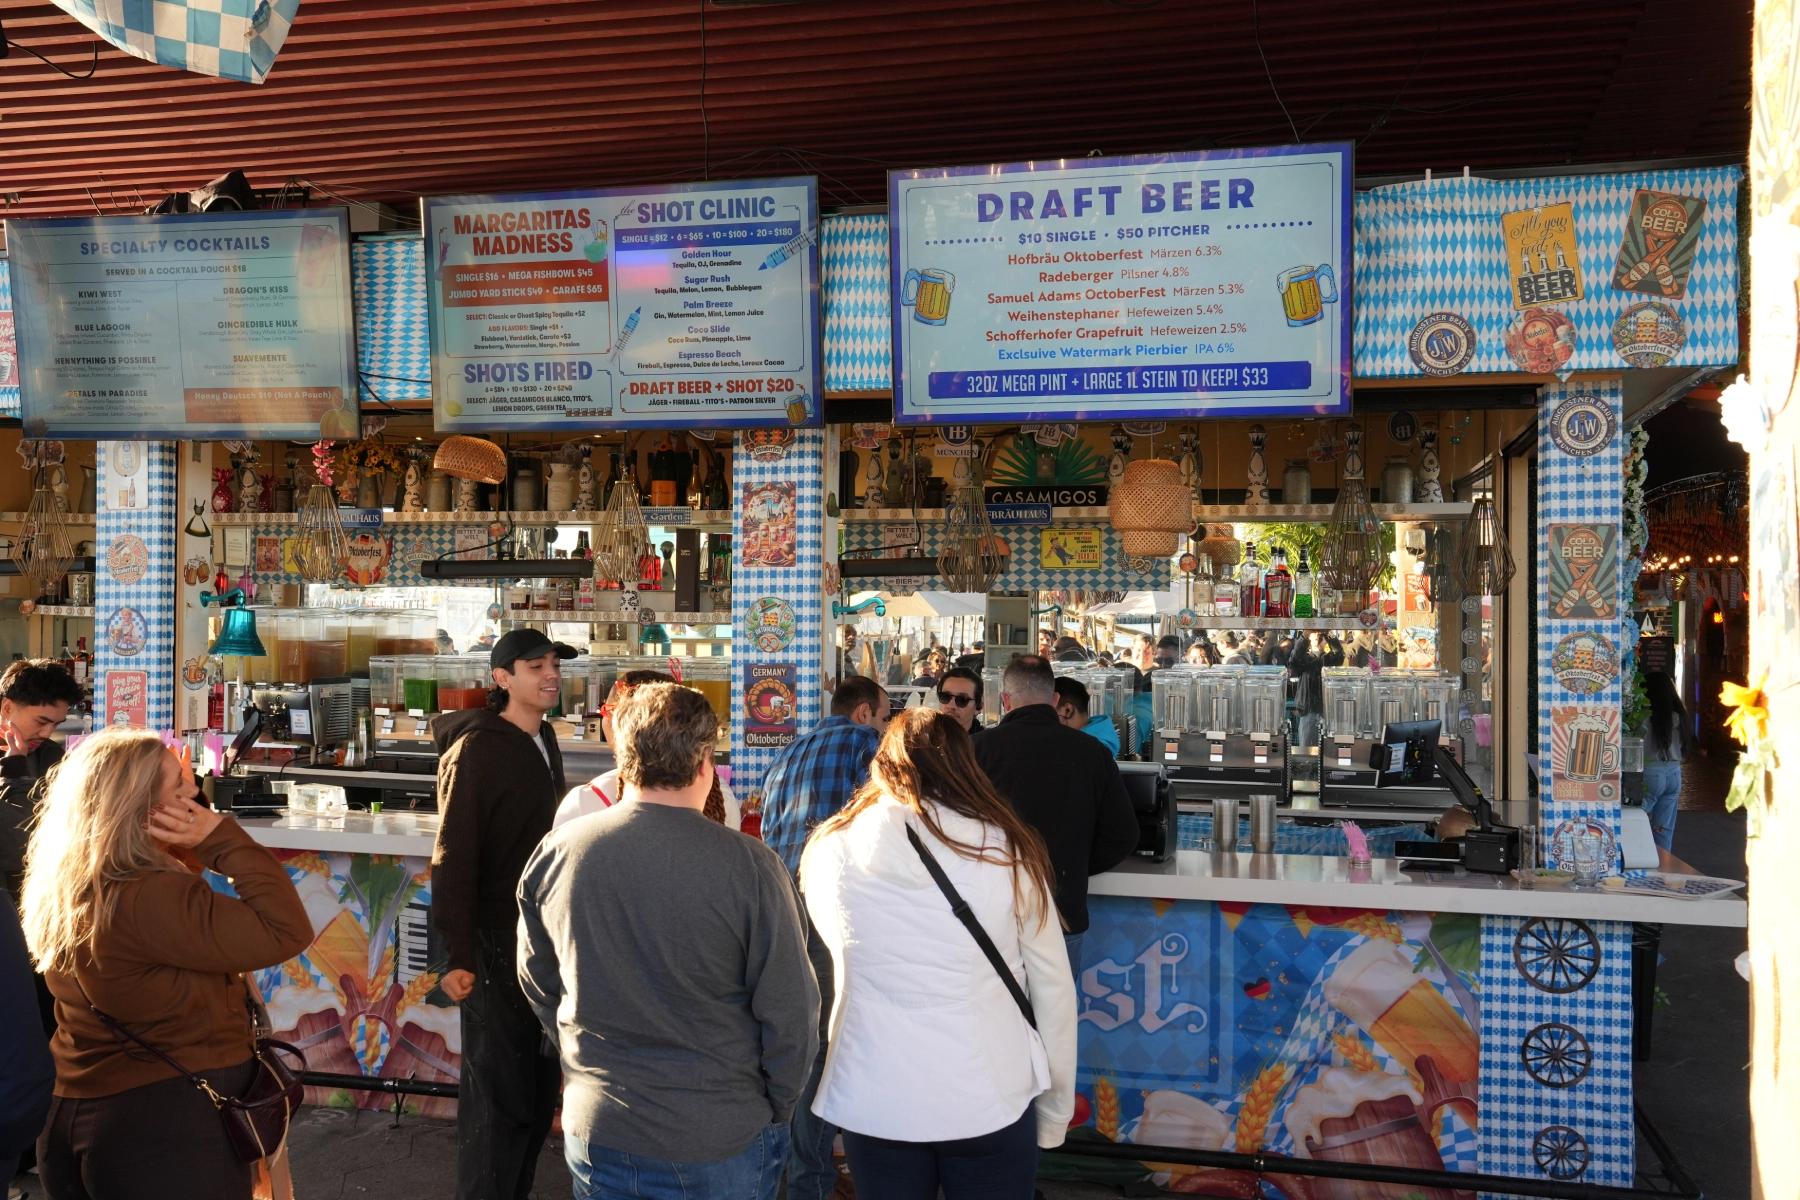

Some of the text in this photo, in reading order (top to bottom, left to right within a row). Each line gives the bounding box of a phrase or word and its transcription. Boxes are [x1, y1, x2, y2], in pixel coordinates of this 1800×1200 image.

[977, 178, 1255, 222] DRAFT BEER
[619, 196, 775, 223] the SHOT CLINIC
[1653, 208, 1681, 219] COLD
[454, 208, 591, 234] MARGARITAS
[1641, 216, 1687, 234] BEER
[1018, 225, 1210, 244] $10 SINGLE $50 PITCHER
[1541, 217, 1568, 239] you
[622, 234, 649, 243] SINGLE
[656, 234, 668, 242] $12
[676, 233, 682, 241] 6
[689, 232, 703, 241] $65
[728, 230, 747, 239] $100
[757, 229, 767, 237] 20
[774, 228, 793, 236] $180
[80, 236, 271, 255] SPECIALTY COCKTAILS
[473, 232, 574, 256] MADNESS
[682, 250, 732, 260] Golden Hour
[1008, 246, 1222, 265] Hofbräu Oktoberfest Märzen 6.3%
[106, 268, 136, 276] SERVED
[149, 267, 155, 275] A
[156, 266, 198, 275] COCKTAIL
[201, 266, 230, 274] POUCH
[672, 262, 696, 270] Tequila,
[456, 268, 593, 282] SINGLE $16 MEGA FISHBOWL $45
[684, 274, 730, 285] Sugar Rush
[1039, 266, 1189, 284] Radeberger Pilsner 4.8%
[78, 290, 122, 298] KIWI WEST
[223, 286, 267, 295] DRAGON'S
[448, 284, 603, 299] JUMBO YARD STICK $49 CARAFE $65
[654, 287, 679, 295] Tequila,
[988, 284, 1245, 305] Samuel Adams OctoberFest Märzen 5.3%
[684, 300, 733, 309] Palm Breeze
[654, 312, 667, 320] Gin,
[708, 310, 724, 318] Mint,
[1008, 304, 1224, 323] Weihenstephaner Hefeweizen 5.4%
[75, 324, 94, 332] BLUE
[218, 320, 298, 329] GINCREDIBLE HULK
[688, 325, 731, 334] Coco Slide
[986, 322, 1248, 342] Schofferhofer Grapefruit Hefeweizen 2.5%
[678, 350, 742, 361] Espresso Beach
[998, 342, 1236, 360] Exclsuive Watermark Pierbier IPA 6%
[55, 356, 157, 365] HENNYTHING IS POSSIBLE
[234, 355, 288, 363] SUAVEMENTE
[464, 360, 593, 383] SHOTS FIRED
[968, 366, 1269, 393] 32OZ MEGA PINT LARGE 1L STEIN TO KEEP! $33
[630, 378, 795, 396] DRAFT BEER SHOT $20
[222, 392, 256, 400] Deutsch
[648, 398, 668, 406] JÄGER
[730, 397, 754, 405] PATRON
[755, 396, 776, 404] SILVER
[949, 426, 967, 440] HB
[992, 490, 1097, 505] CASAMIGOS
[650, 510, 684, 521] Garden
[1561, 546, 1604, 558] BEER
[752, 668, 786, 677] GERMANY
[747, 734, 794, 747] Oktoberfest
